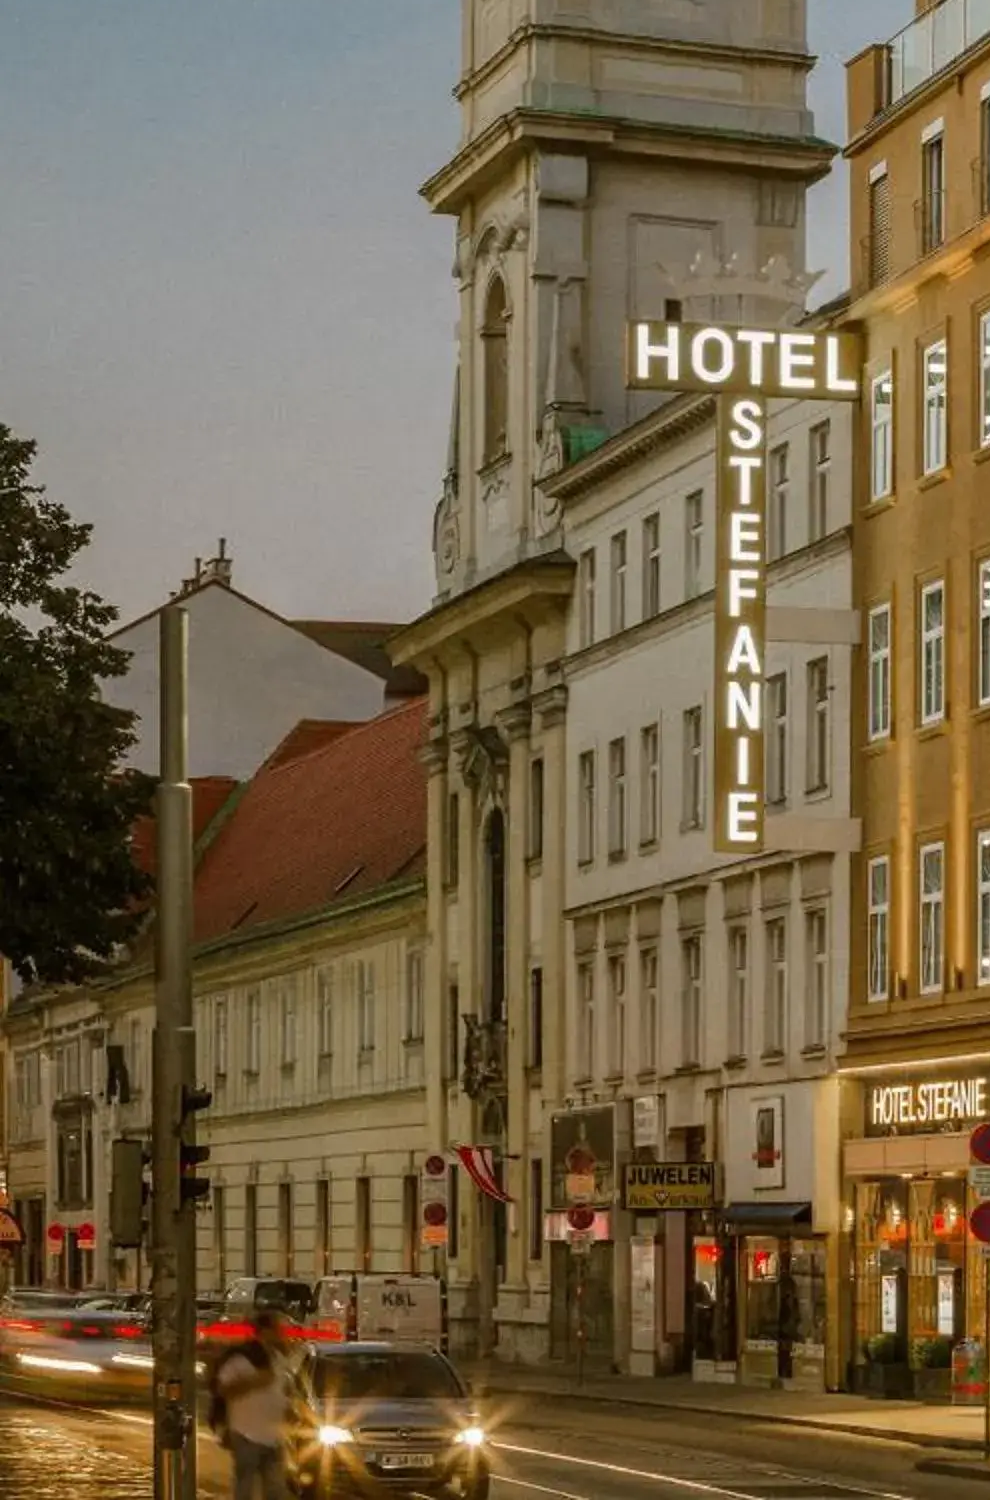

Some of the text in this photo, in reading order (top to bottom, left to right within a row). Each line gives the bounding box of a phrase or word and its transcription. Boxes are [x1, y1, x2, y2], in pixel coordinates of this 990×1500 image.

[635, 322, 858, 392] HOTEL
[725, 399, 762, 844] STEFANIE
[872, 1078, 987, 1125] HOTEL STEFANIE
[627, 1166, 712, 1185] JUWELEN
